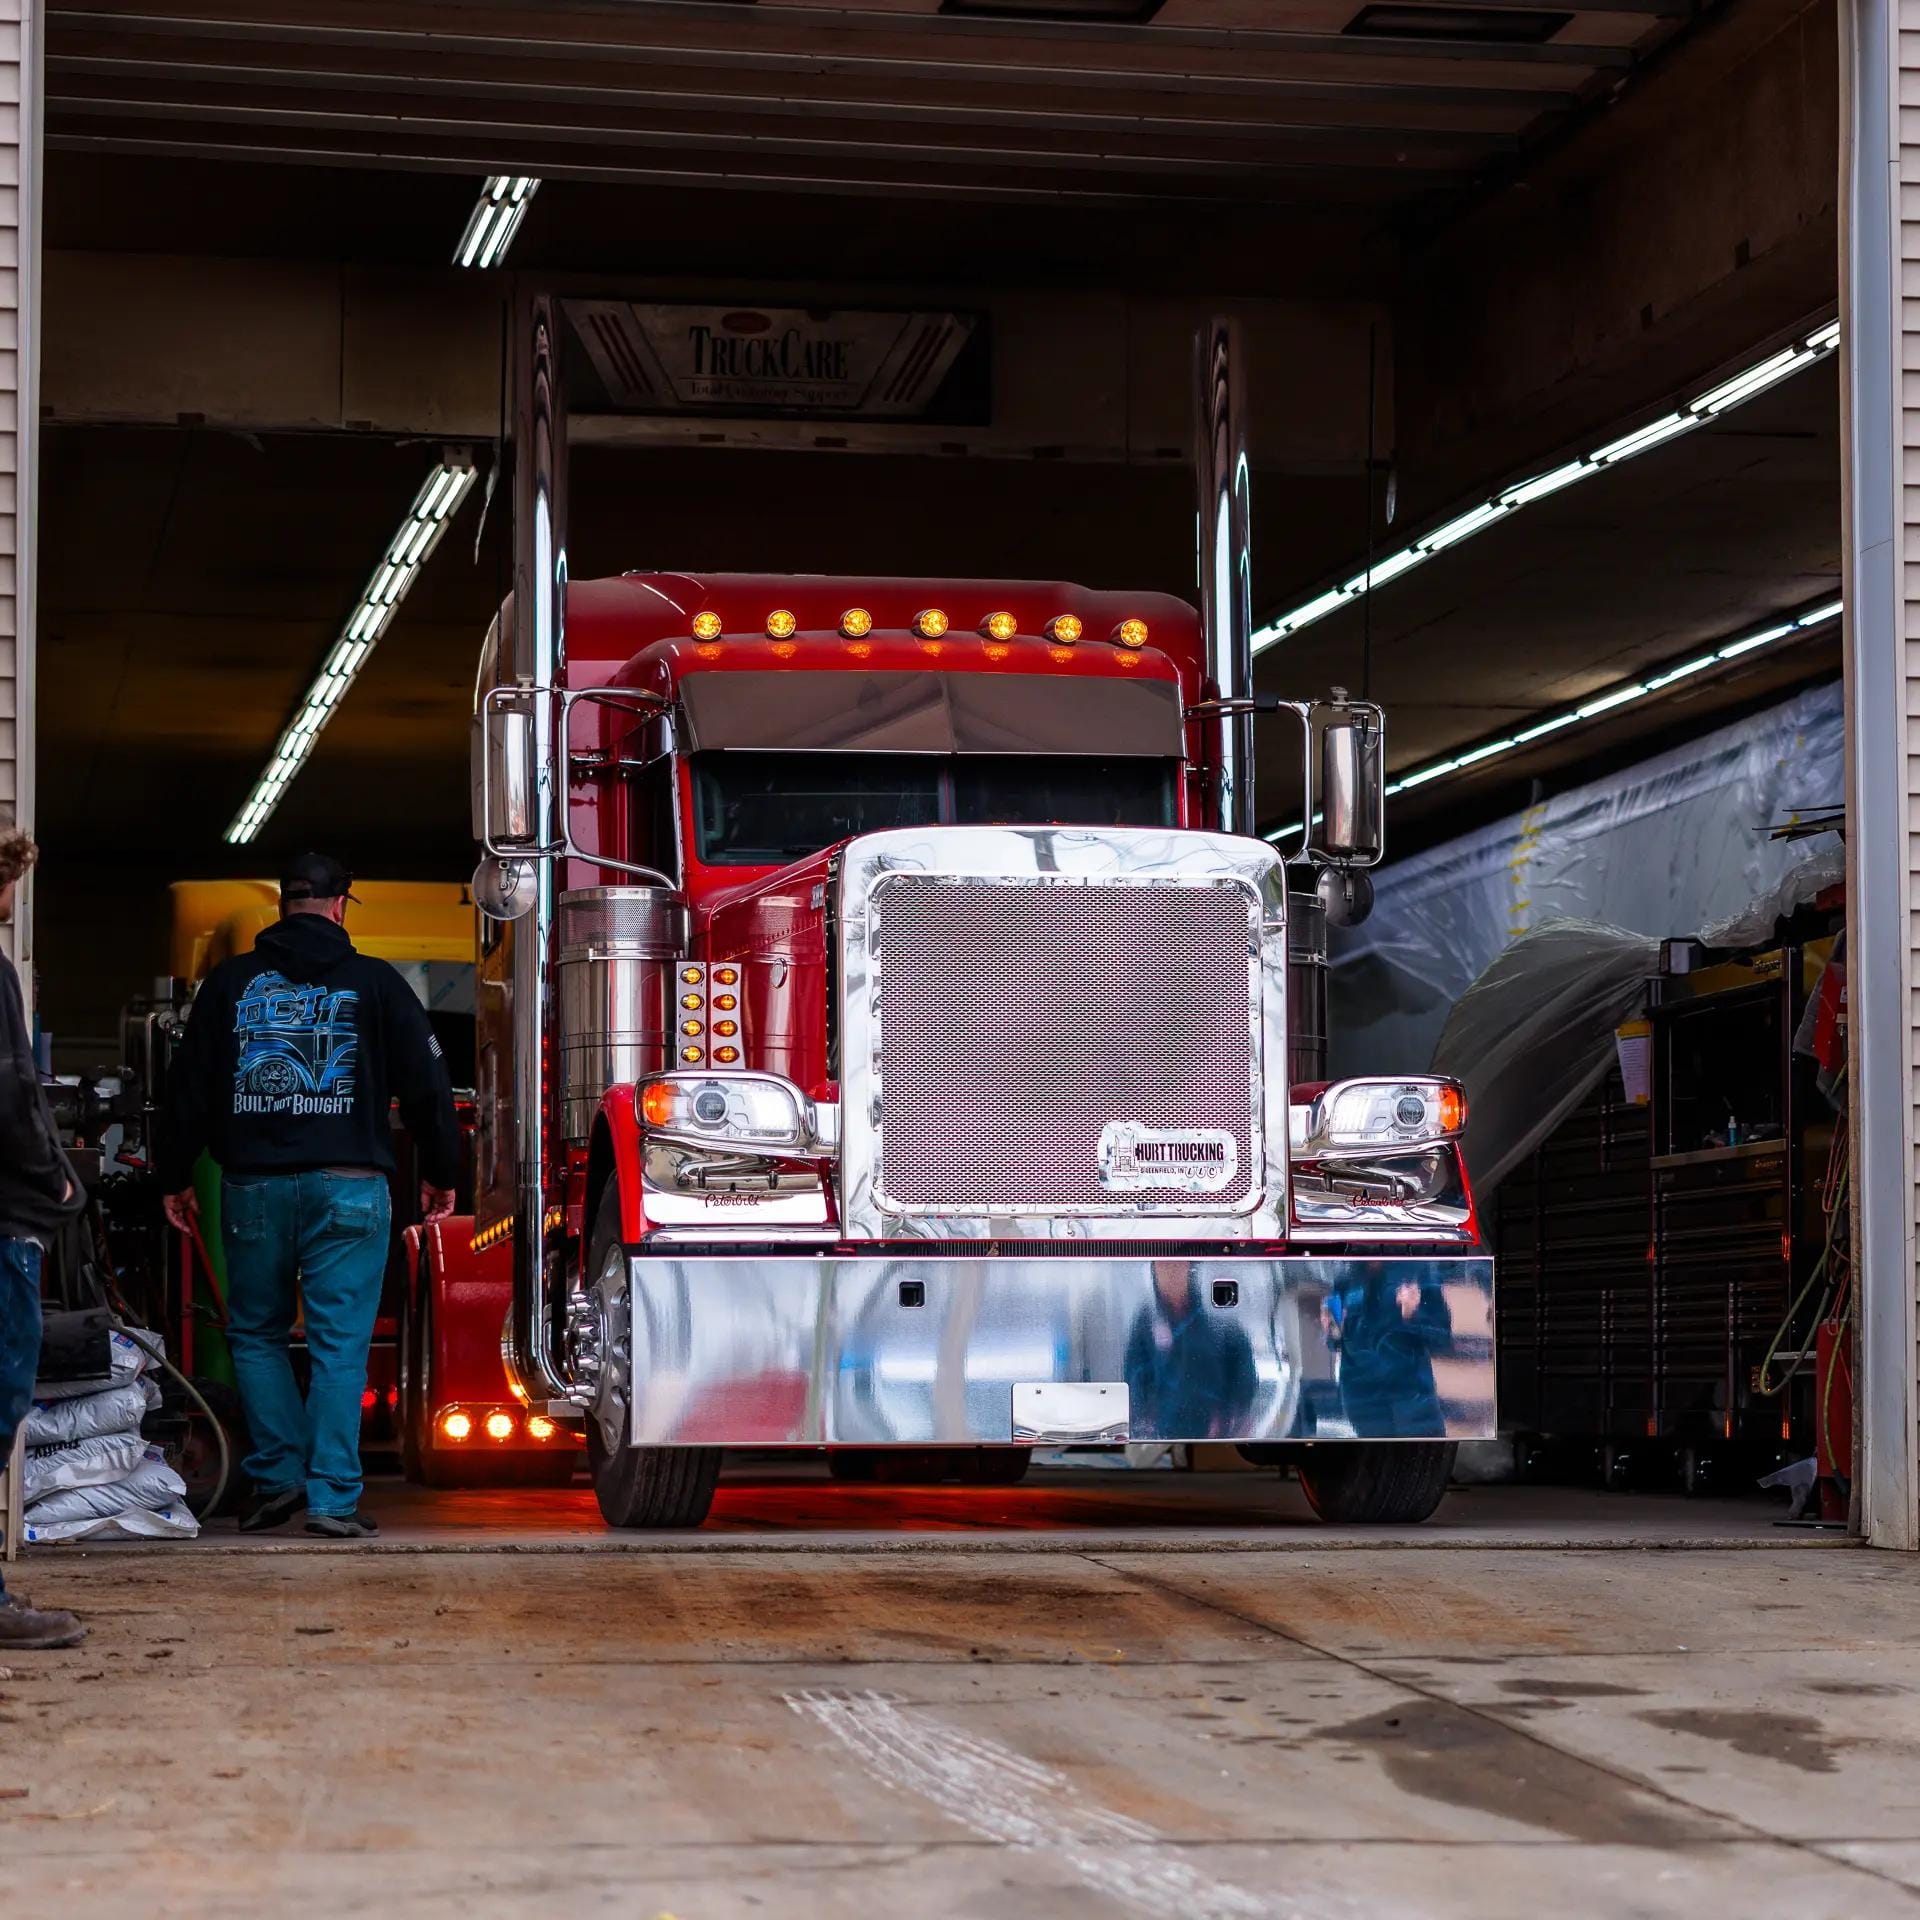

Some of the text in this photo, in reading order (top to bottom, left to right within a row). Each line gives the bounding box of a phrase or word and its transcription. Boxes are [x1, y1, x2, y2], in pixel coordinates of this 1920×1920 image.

[233, 1093, 354, 1115] BUILT NOT BOUGHT
[1136, 1142, 1224, 1161] HURT TRUCKING
[704, 1193, 763, 1208] Peterbilt
[1352, 1195, 1406, 1208] Peterbilt
